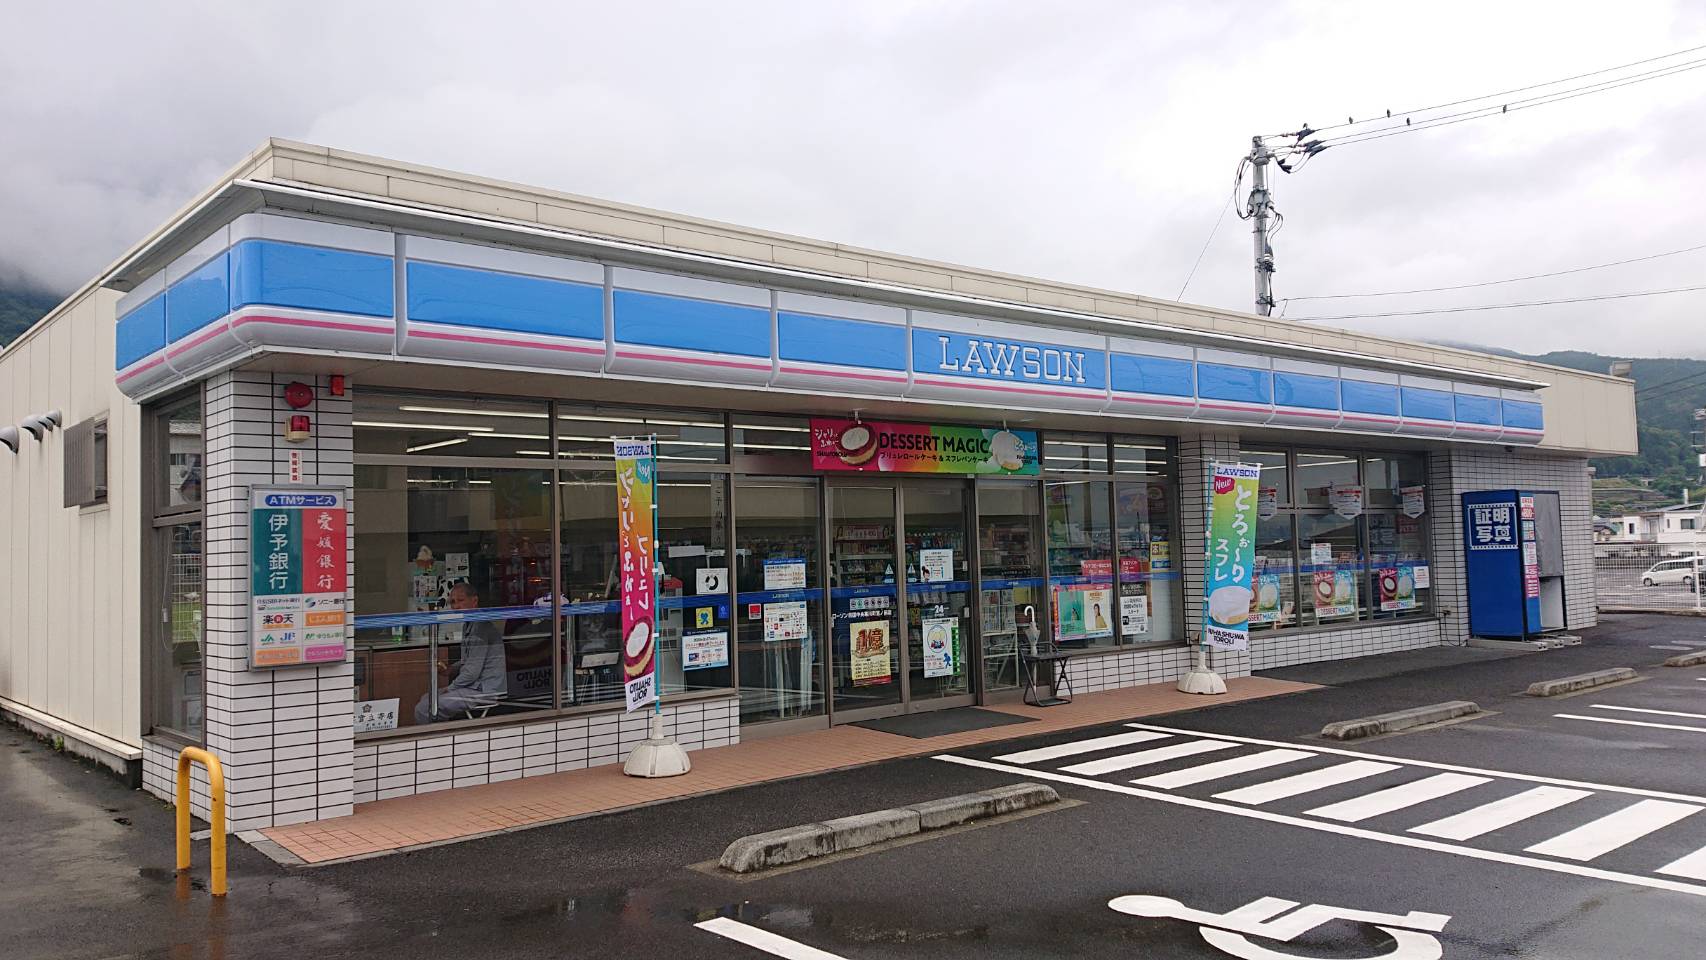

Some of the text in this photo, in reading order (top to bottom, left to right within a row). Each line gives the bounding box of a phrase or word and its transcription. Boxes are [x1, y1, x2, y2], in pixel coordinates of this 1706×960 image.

[938, 335, 1086, 384] LAWSON
[880, 432, 989, 454] DESSERT MAGIC
[880, 452, 938, 462] ブリュレロールケーキ
[946, 456, 989, 464] スフレパンケーキ
[1216, 467, 1258, 477] LAWSON
[1215, 478, 1232, 491] New
[269, 495, 334, 506] ATMサービス
[1474, 507, 1510, 525] 証明
[1476, 525, 1512, 543] 写真
[268, 513, 289, 590] 伊予銀行
[316, 511, 335, 590] 愛媛銀行
[1215, 538, 1229, 581] スフレ
[934, 604, 945, 614] 24
